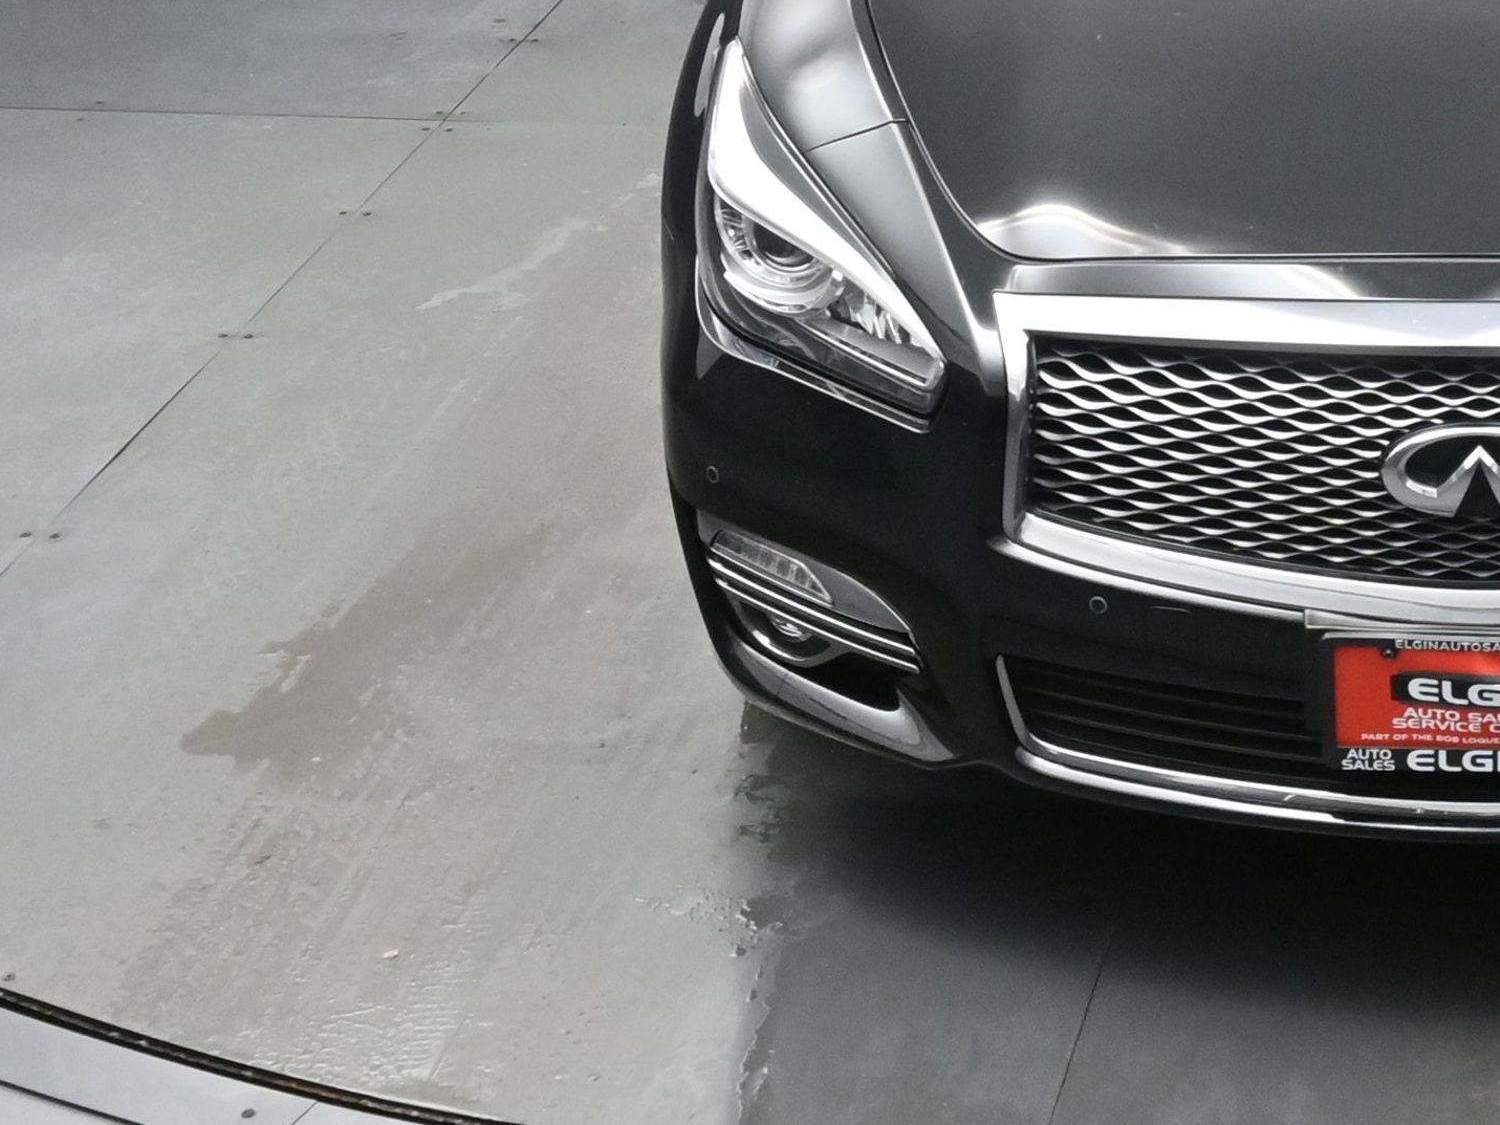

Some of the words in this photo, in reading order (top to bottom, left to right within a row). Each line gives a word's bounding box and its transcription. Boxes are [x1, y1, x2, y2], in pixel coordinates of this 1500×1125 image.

[1403, 707, 1460, 722] AUTO
[1392, 718, 1482, 733] SERVICE
[1361, 733, 1389, 741] PART
[1393, 733, 1408, 741] OF
[1411, 733, 1433, 742] THE
[1347, 748, 1392, 760] AUTO
[1341, 759, 1396, 772] SALES
